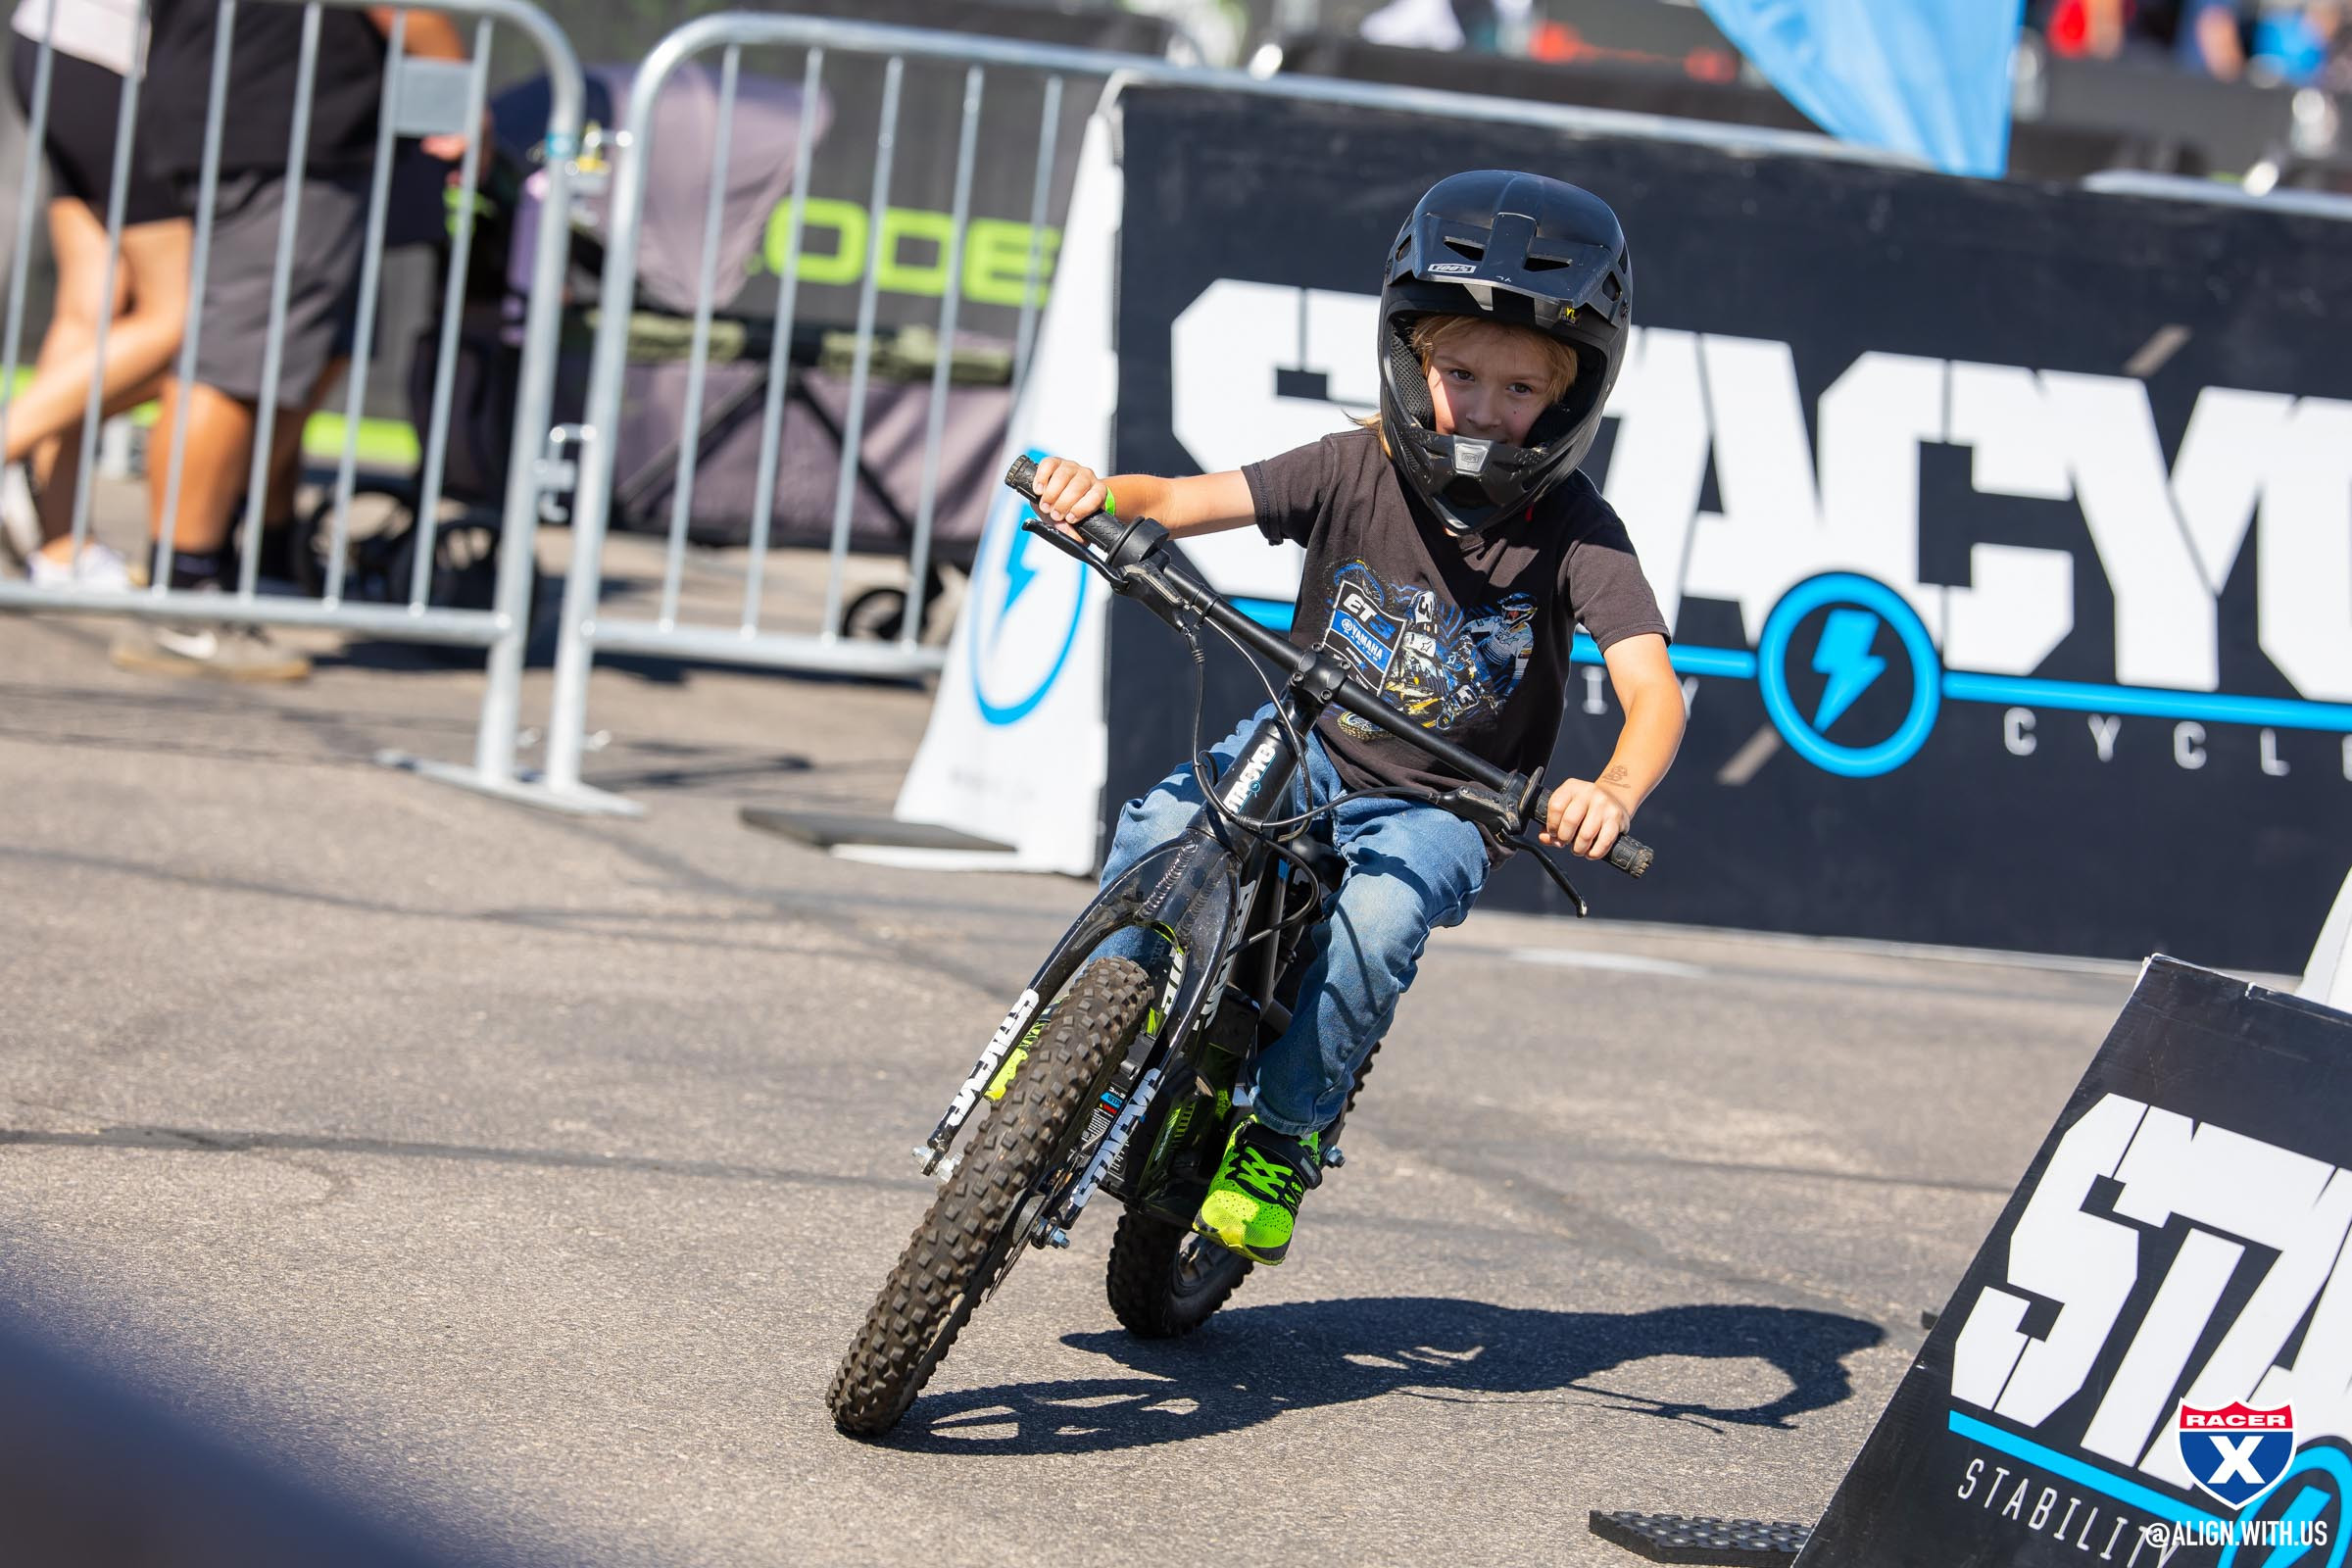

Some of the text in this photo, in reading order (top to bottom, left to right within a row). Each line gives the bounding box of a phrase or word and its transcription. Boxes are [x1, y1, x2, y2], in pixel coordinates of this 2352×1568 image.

[748, 196, 1061, 312] ODE
[1433, 264, 1472, 272] 100%
[1344, 593, 1396, 641] ET3
[1349, 625, 1383, 662] YAMAHA
[2004, 706, 2352, 782] CYCL
